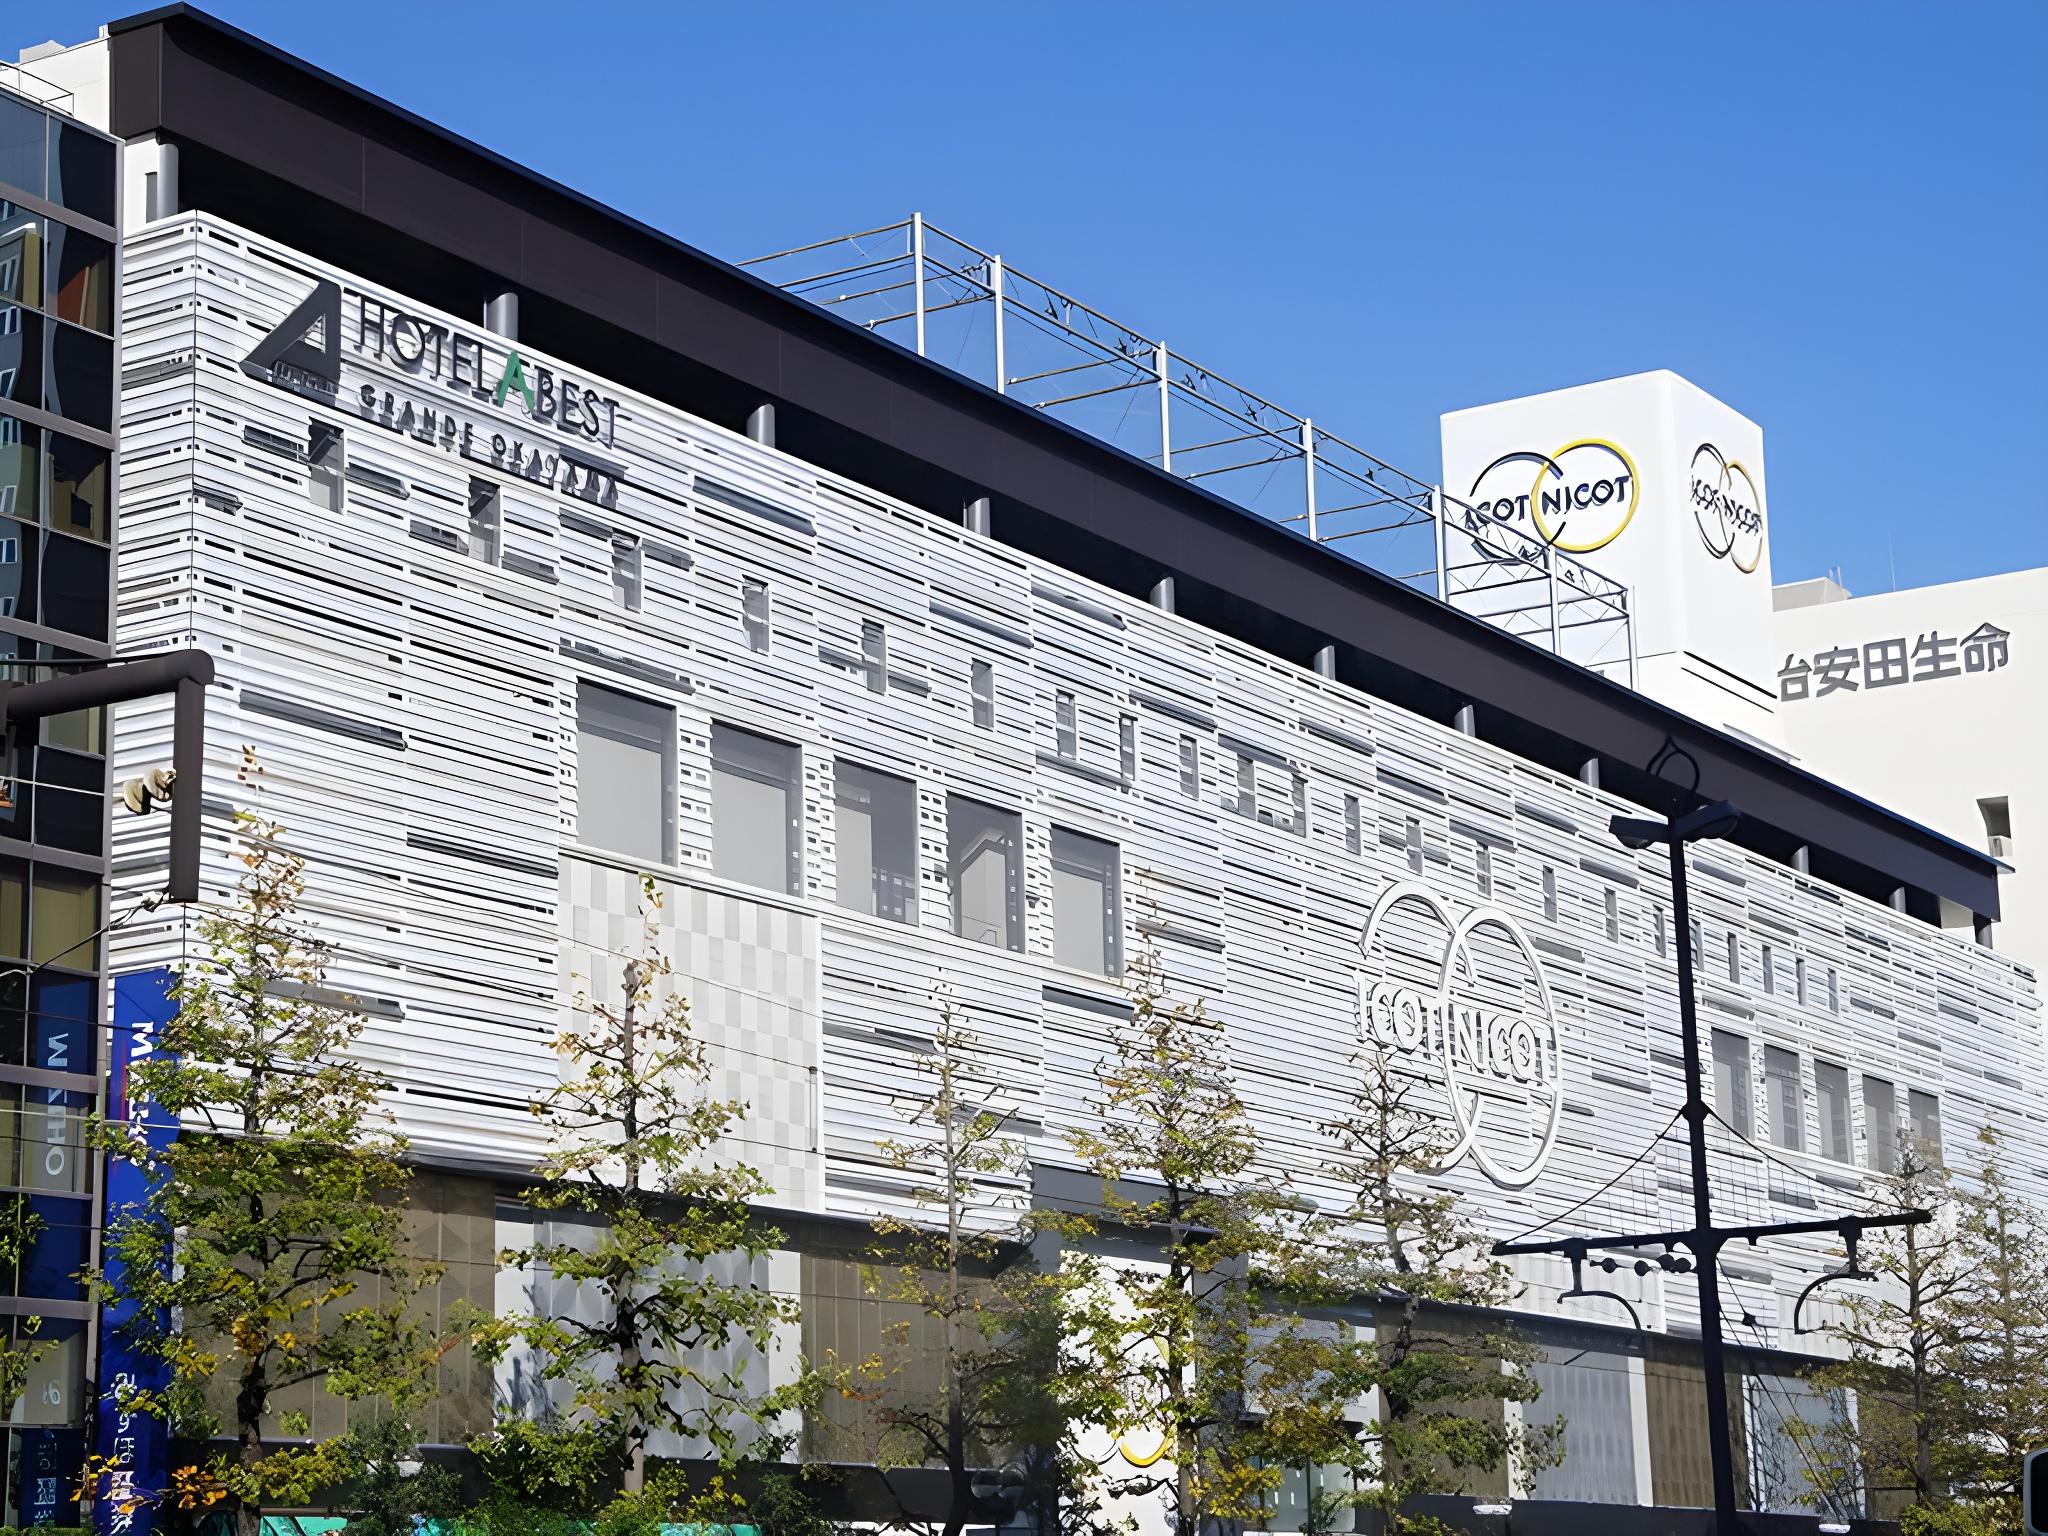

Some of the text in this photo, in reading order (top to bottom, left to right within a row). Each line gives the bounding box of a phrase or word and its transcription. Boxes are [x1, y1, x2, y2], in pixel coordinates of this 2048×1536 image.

[357, 294, 494, 397] HOTEL
[360, 384, 474, 444] GRANDE
[1541, 475, 1630, 515] NICOT
